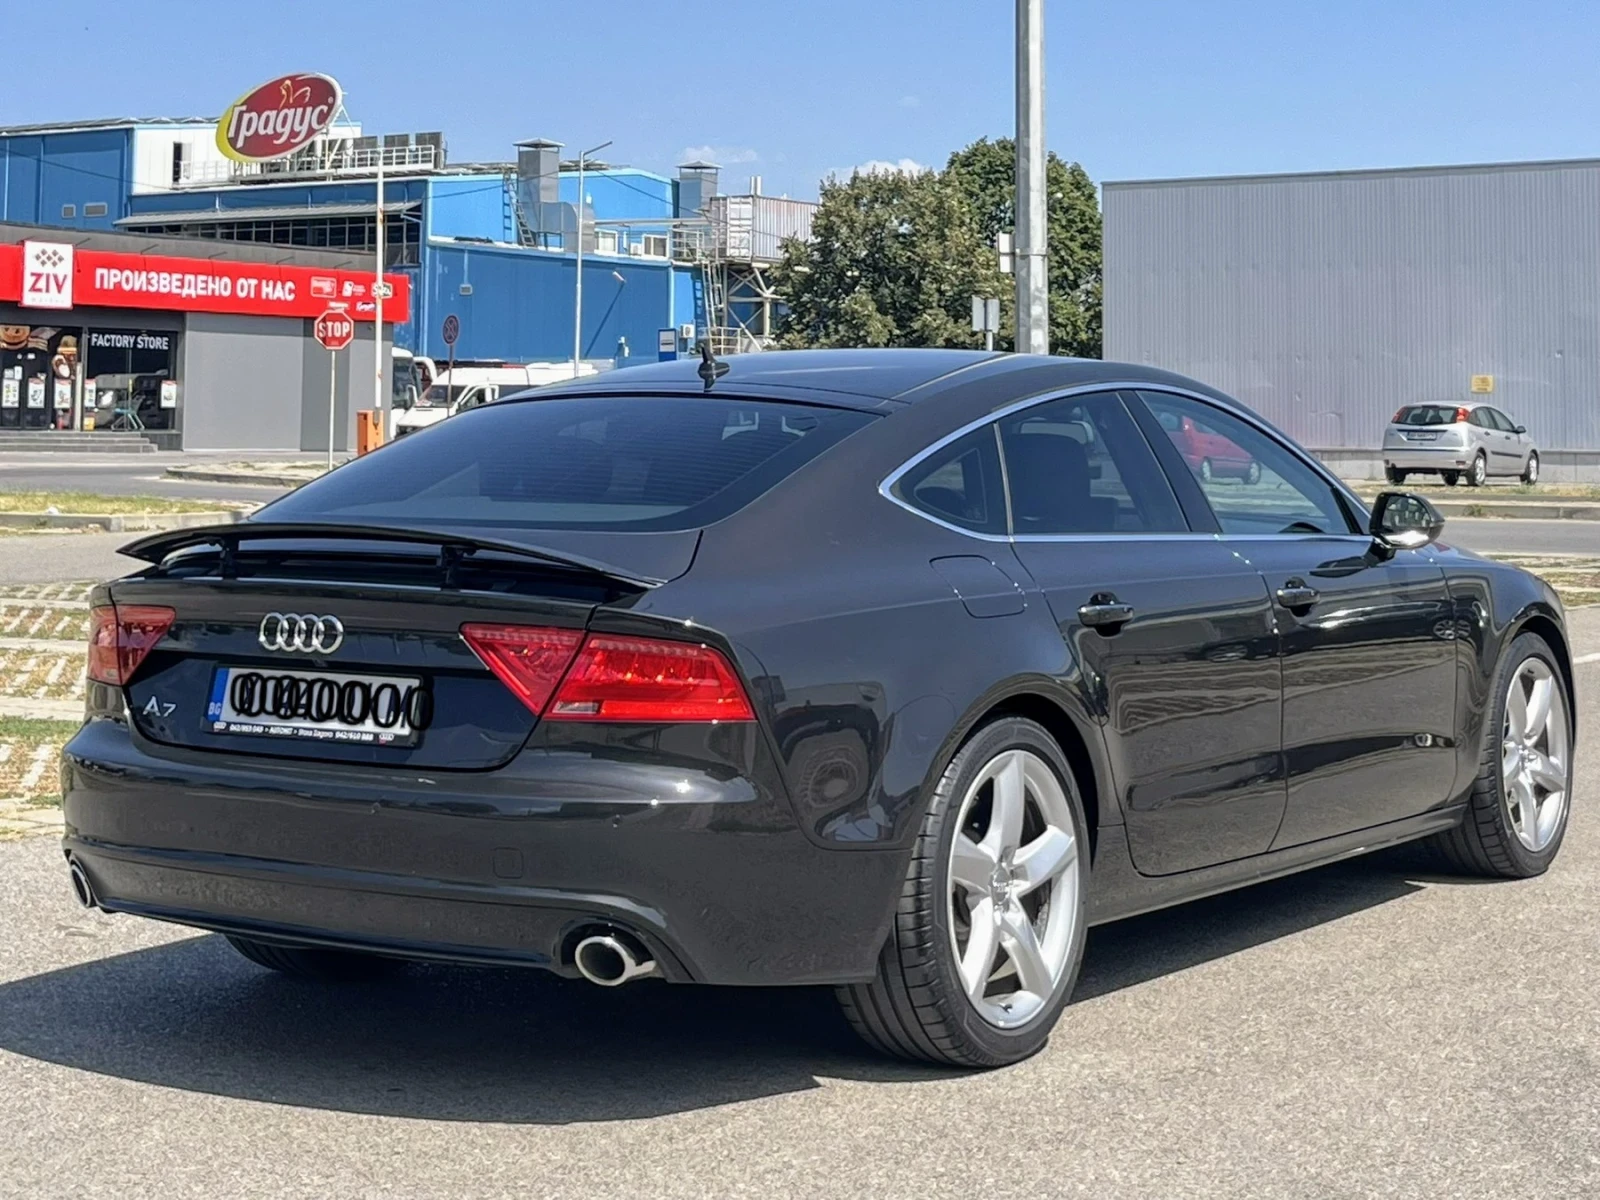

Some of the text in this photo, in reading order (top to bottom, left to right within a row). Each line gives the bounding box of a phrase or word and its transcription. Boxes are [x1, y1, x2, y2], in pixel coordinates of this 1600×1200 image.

[228, 105, 328, 148] Градус
[28, 272, 67, 294] ZIV
[95, 268, 232, 298] ПРОИЗВЕДЕНО
[236, 278, 258, 298] ОТ
[261, 280, 296, 301] НАС
[318, 321, 350, 338] STOP
[91, 333, 169, 350] FACTORY STORE
[142, 696, 176, 717] A7
[208, 702, 222, 715] BG
